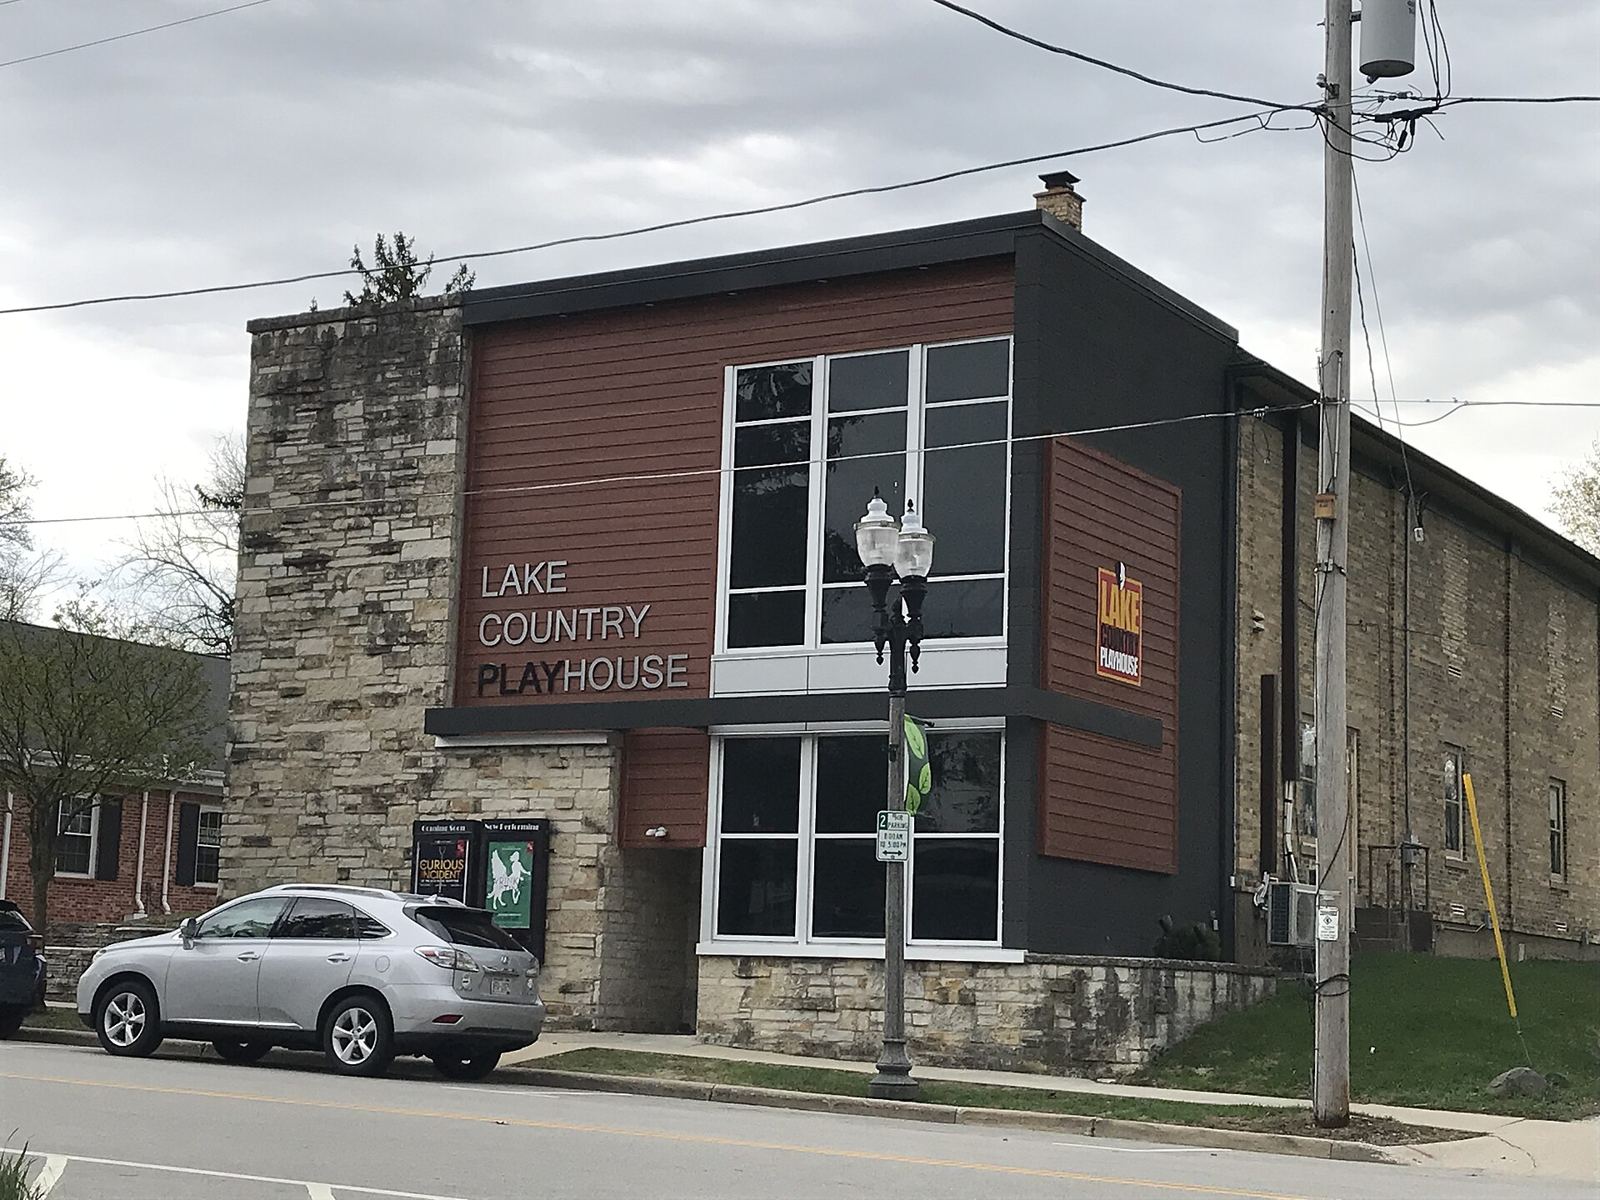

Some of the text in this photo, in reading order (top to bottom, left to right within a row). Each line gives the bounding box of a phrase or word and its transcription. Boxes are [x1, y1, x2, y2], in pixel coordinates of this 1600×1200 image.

[481, 560, 568, 598] LAKE
[478, 604, 651, 647] COUNTRY
[1101, 580, 1140, 635] LAKE
[478, 653, 689, 696] PLAYHOUSE
[1100, 646, 1139, 677] PLAYHOUSE
[880, 814, 886, 828] 2
[419, 859, 465, 871] CURIOUS
